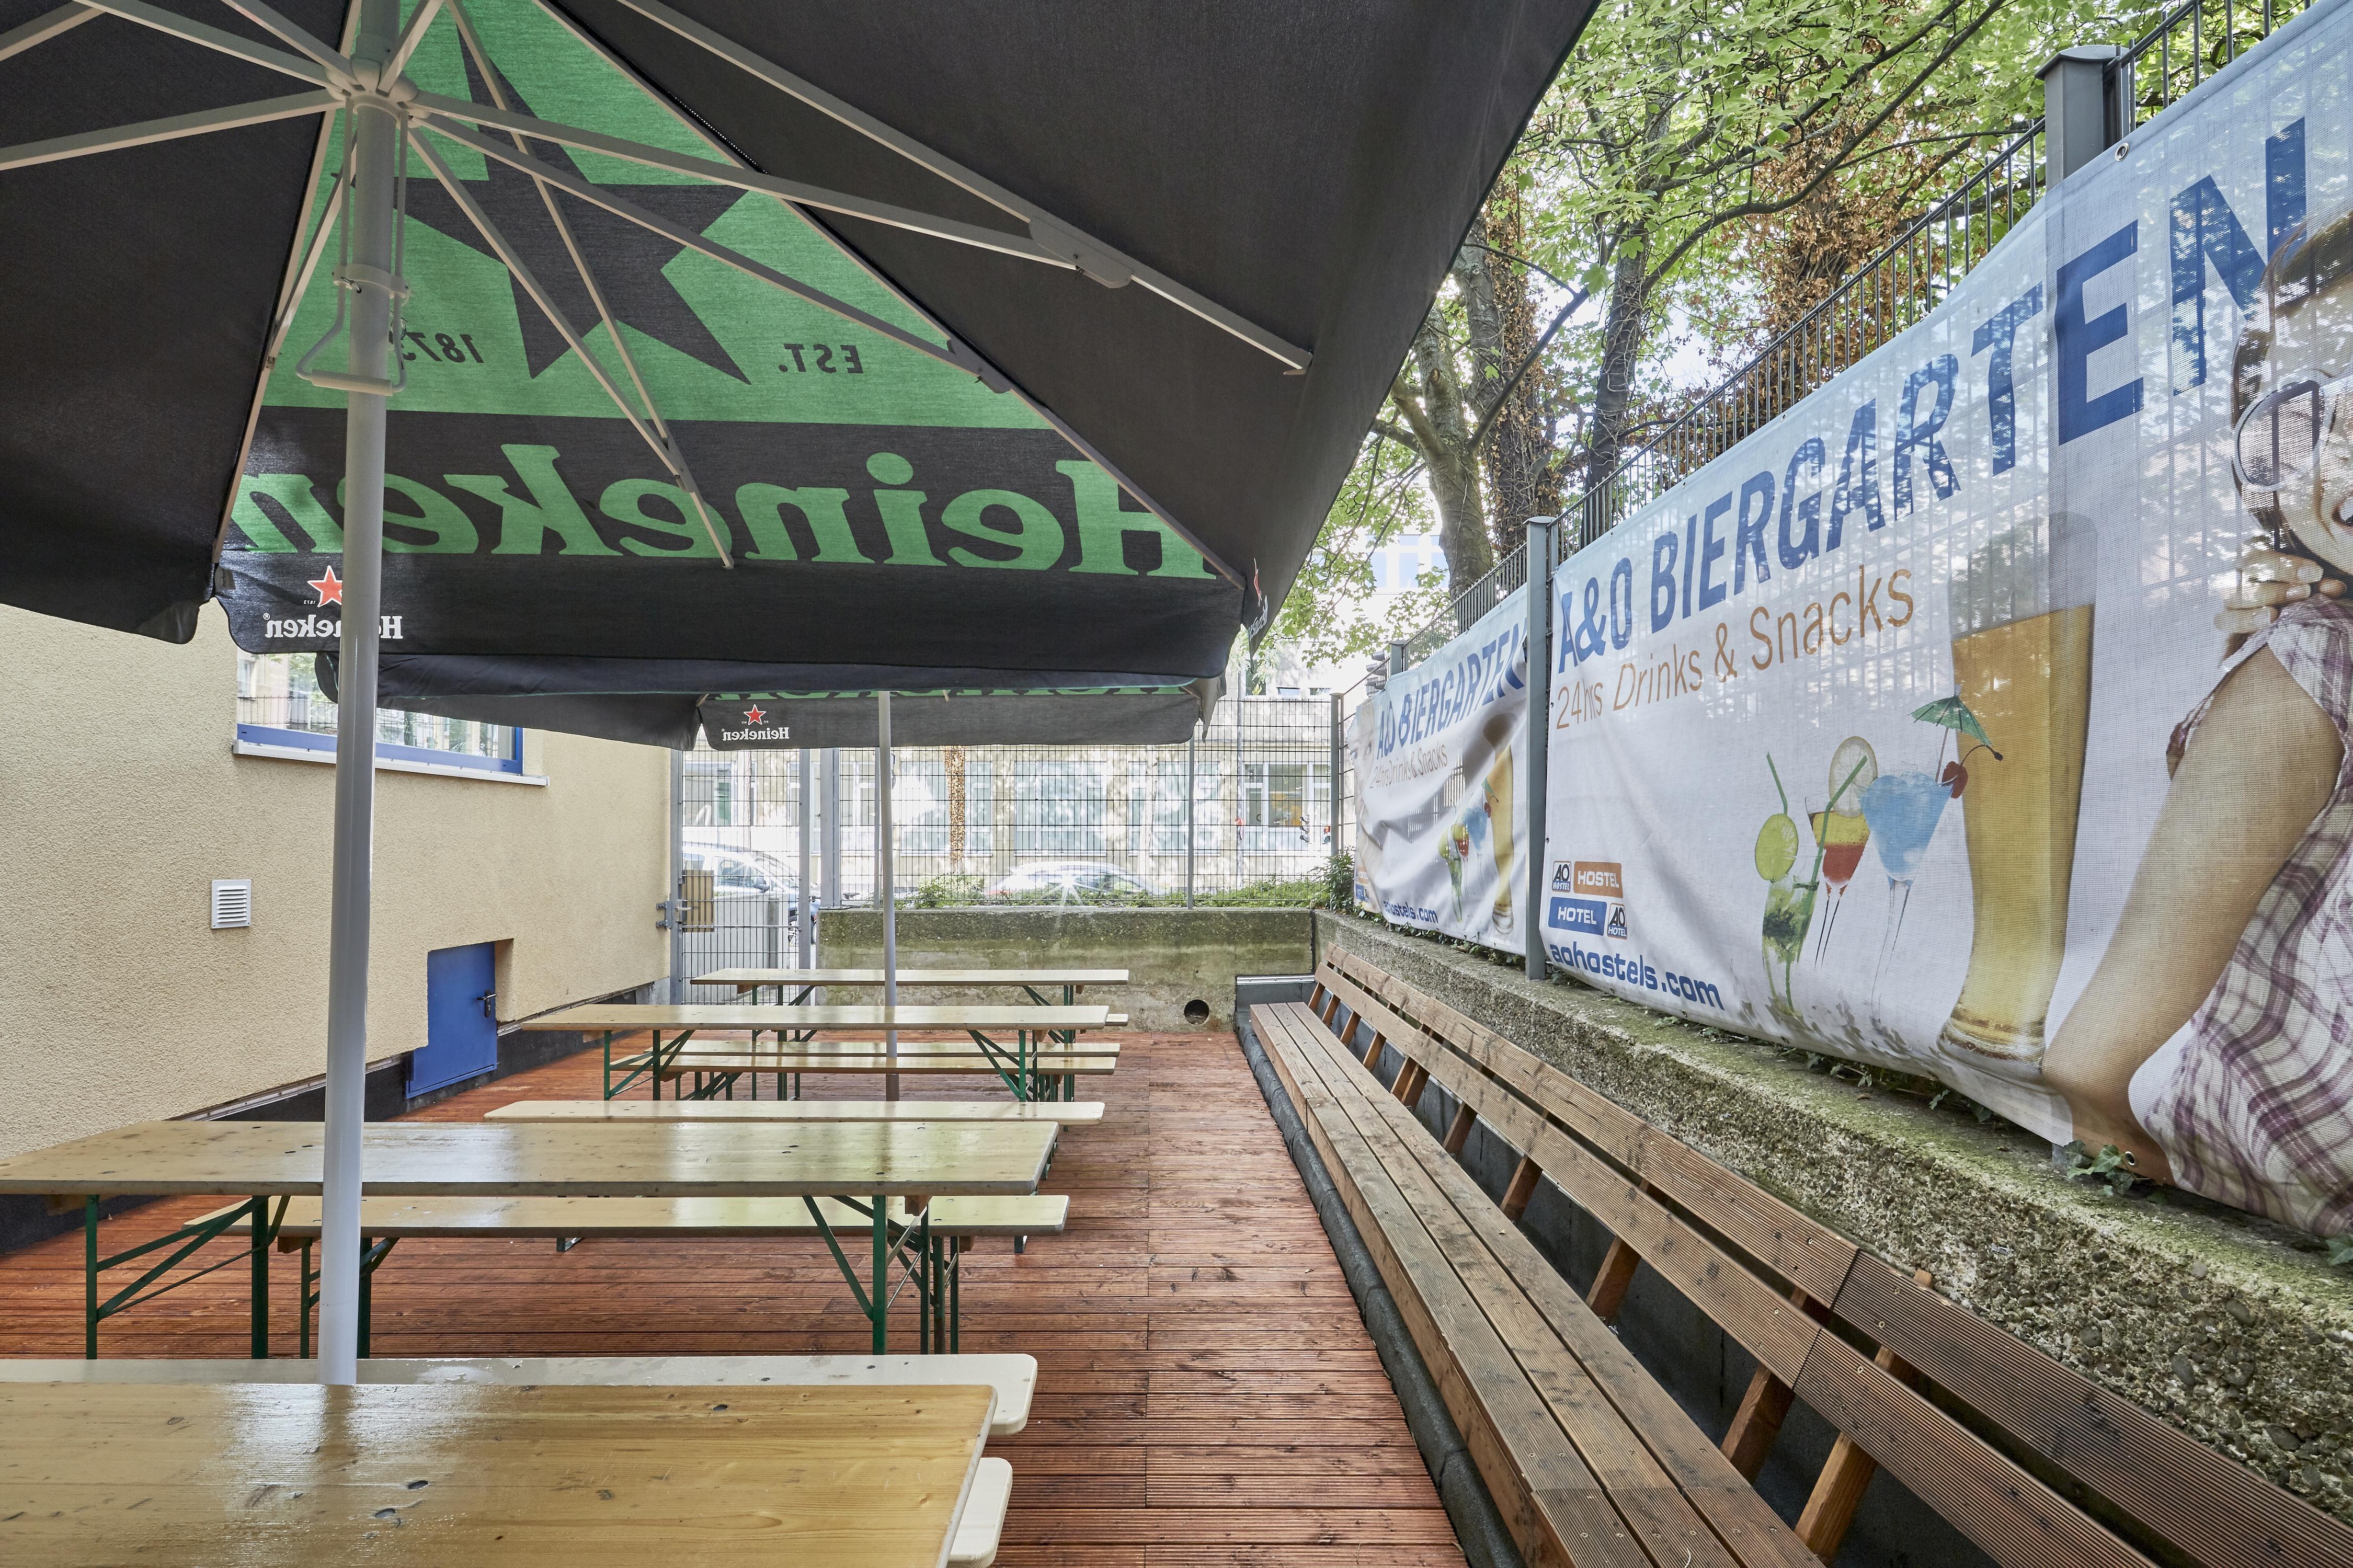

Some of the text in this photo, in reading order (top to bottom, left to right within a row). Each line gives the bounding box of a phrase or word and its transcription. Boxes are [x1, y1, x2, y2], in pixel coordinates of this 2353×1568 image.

[1558, 116, 2307, 674] A&O BIERGARTEN
[1556, 564, 1914, 729] 24hrs Drinks & Snacks
[1418, 739, 1448, 776] Snacks
[1552, 882, 1570, 891] HOSTEL
[1577, 871, 1620, 888] HOSTEL
[1557, 906, 1597, 925] HOTEL
[1608, 926, 1627, 937] HOTEL
[1549, 941, 1726, 1011] aohostels.com
